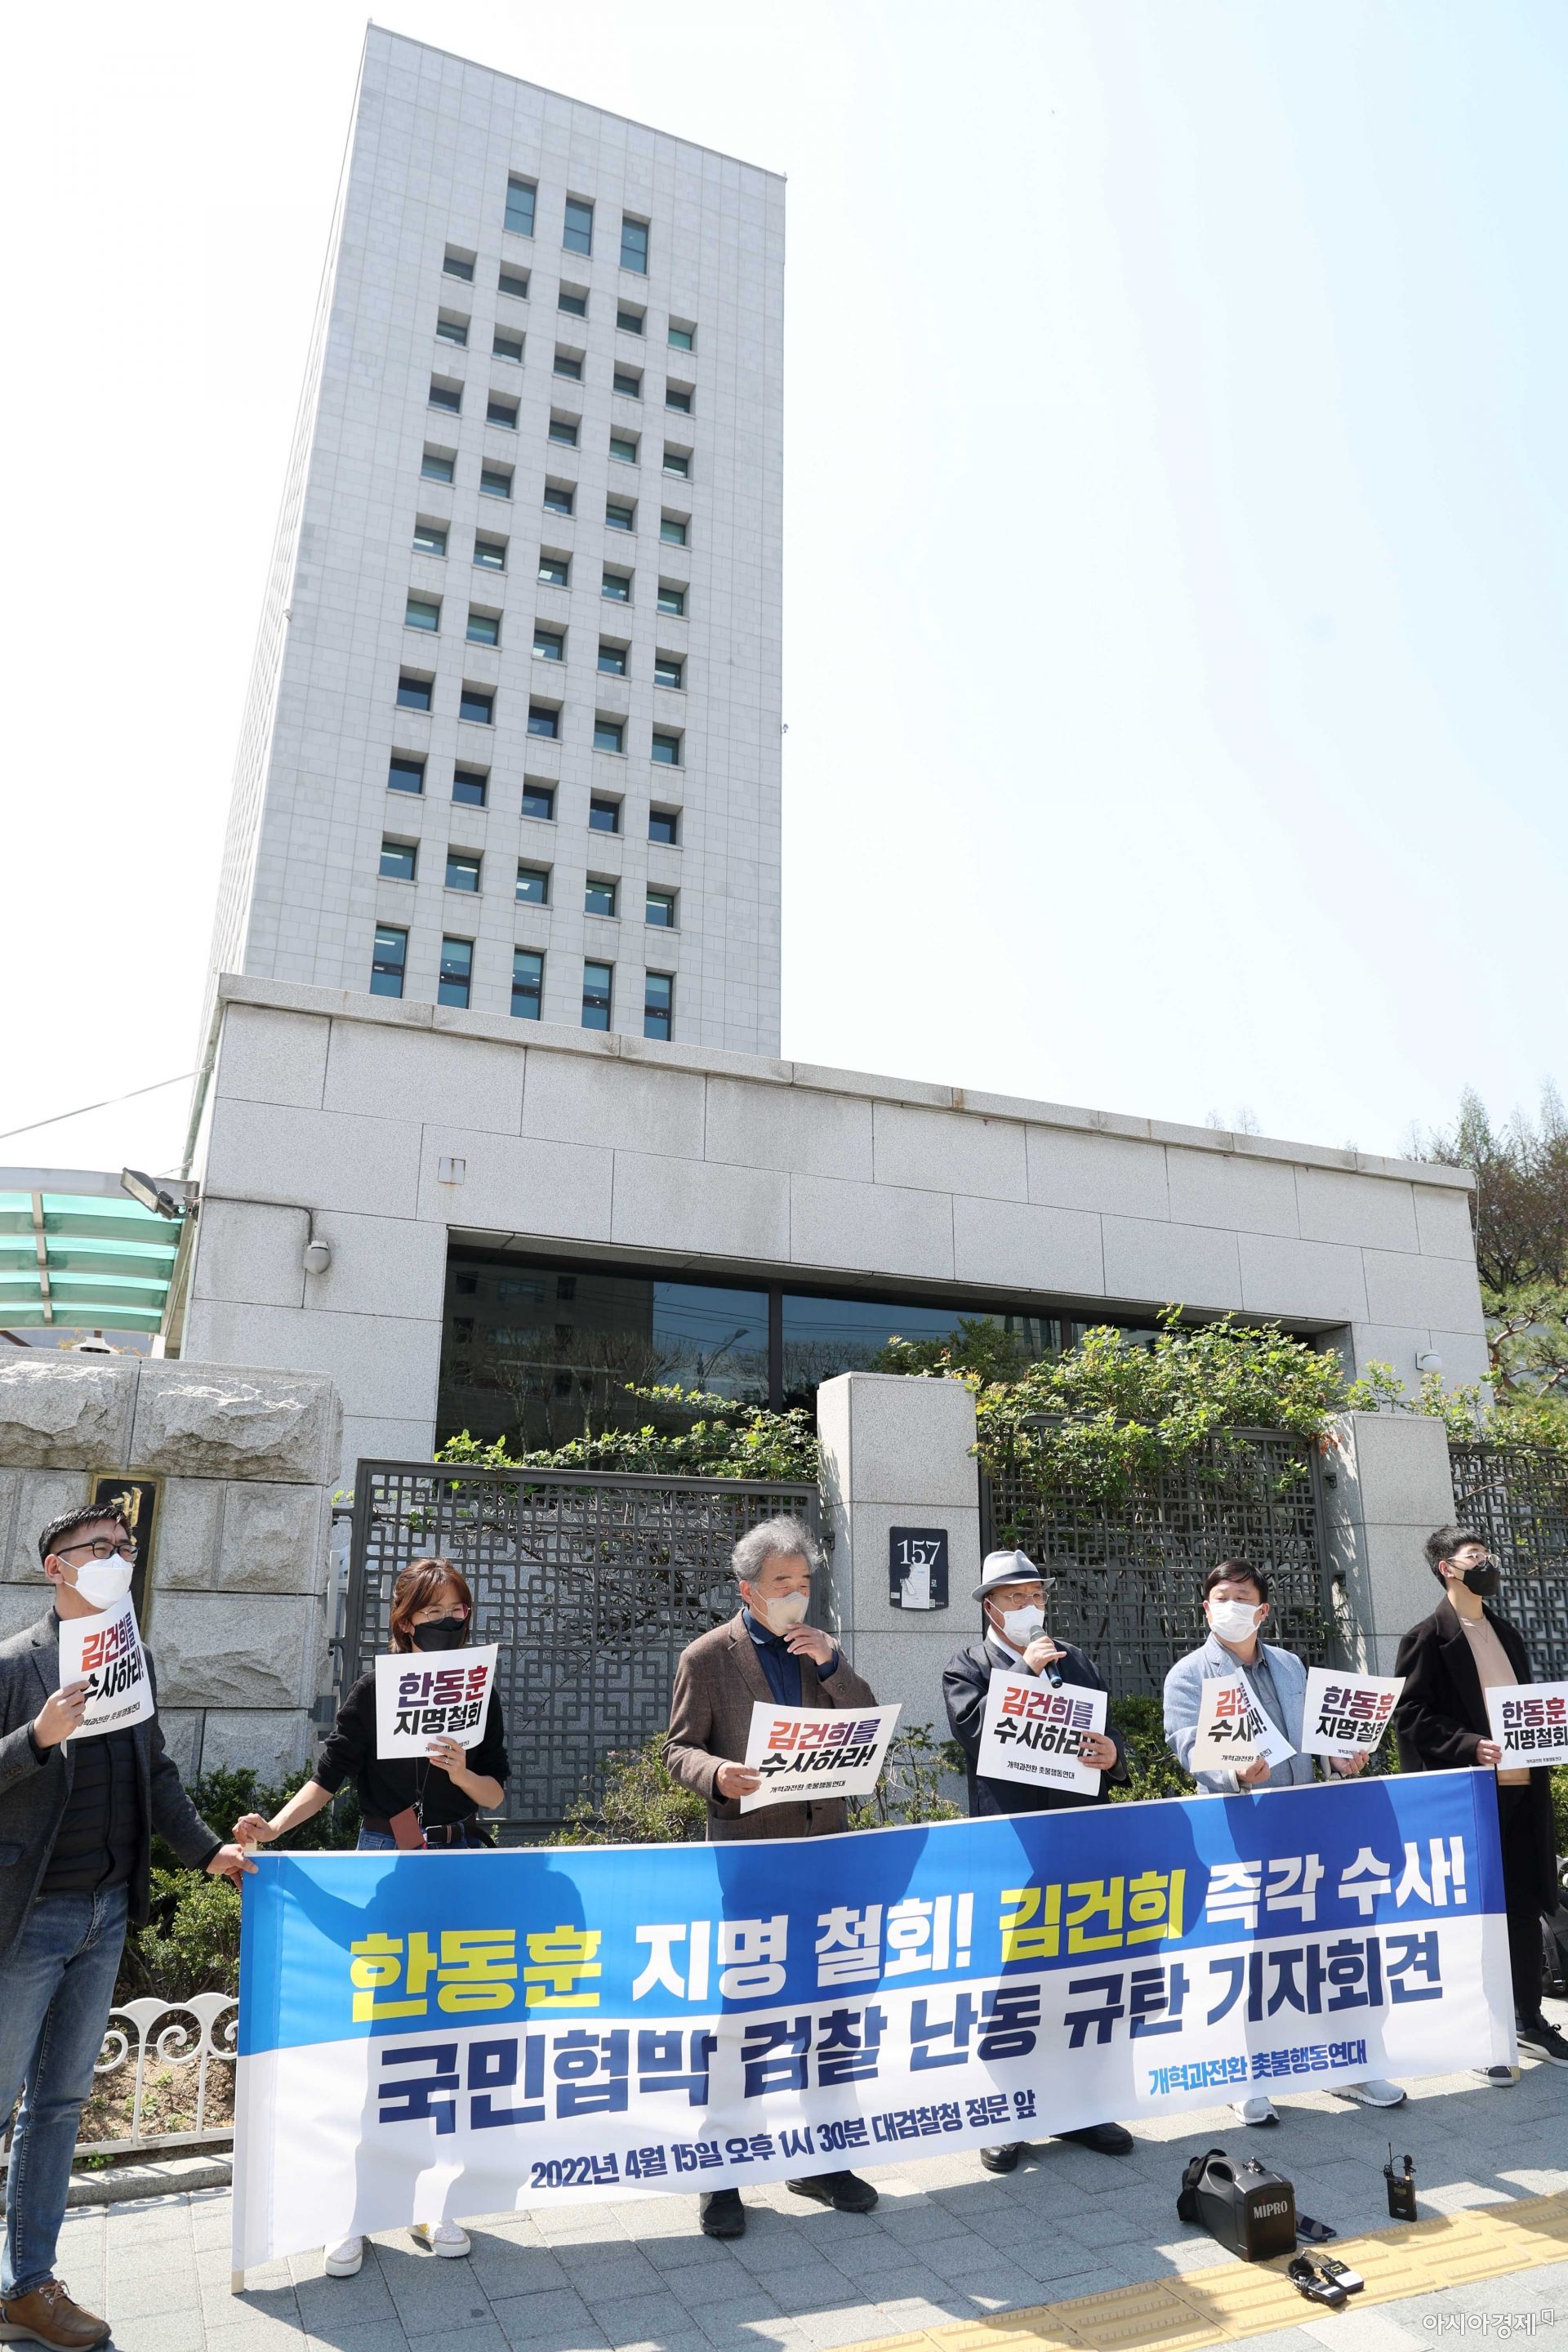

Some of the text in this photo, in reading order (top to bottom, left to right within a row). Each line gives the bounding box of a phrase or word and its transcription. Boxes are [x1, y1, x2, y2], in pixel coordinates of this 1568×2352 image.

[897, 1539, 941, 1565] 157
[81, 1611, 136, 1672] 김건희를
[80, 1646, 145, 1703] 수사하라!
[398, 1665, 488, 1708] 한동훈
[393, 1700, 483, 1735] 지명철회
[1001, 1686, 1094, 1730] 김건희를
[1321, 1686, 1396, 1721] 한동훈
[1502, 1697, 1567, 1729] 한동훈
[768, 1718, 882, 1750] 김건희를
[1315, 1715, 1386, 1743] 지명철회
[1504, 1726, 1568, 1751] 지명철회
[759, 1744, 878, 1778] 수사하라!
[1007, 1761, 1038, 1773] 개혁과전환
[770, 1784, 804, 1793] 개혁과전환
[350, 1835, 1468, 2023] 한동훈 지명 철회! 김건희 즉각 수사!
[378, 1930, 1443, 2136] 국민협박 검찰 난동 규탄 기자회견
[1148, 2039, 1368, 2096] 개혁과전환 촛불행동연대
[531, 2089, 1037, 2189] 2022년 4월 15일 오후 1시 30분 대검찰청 정문 앞
[1254, 2197, 1288, 2219] MIPRO
